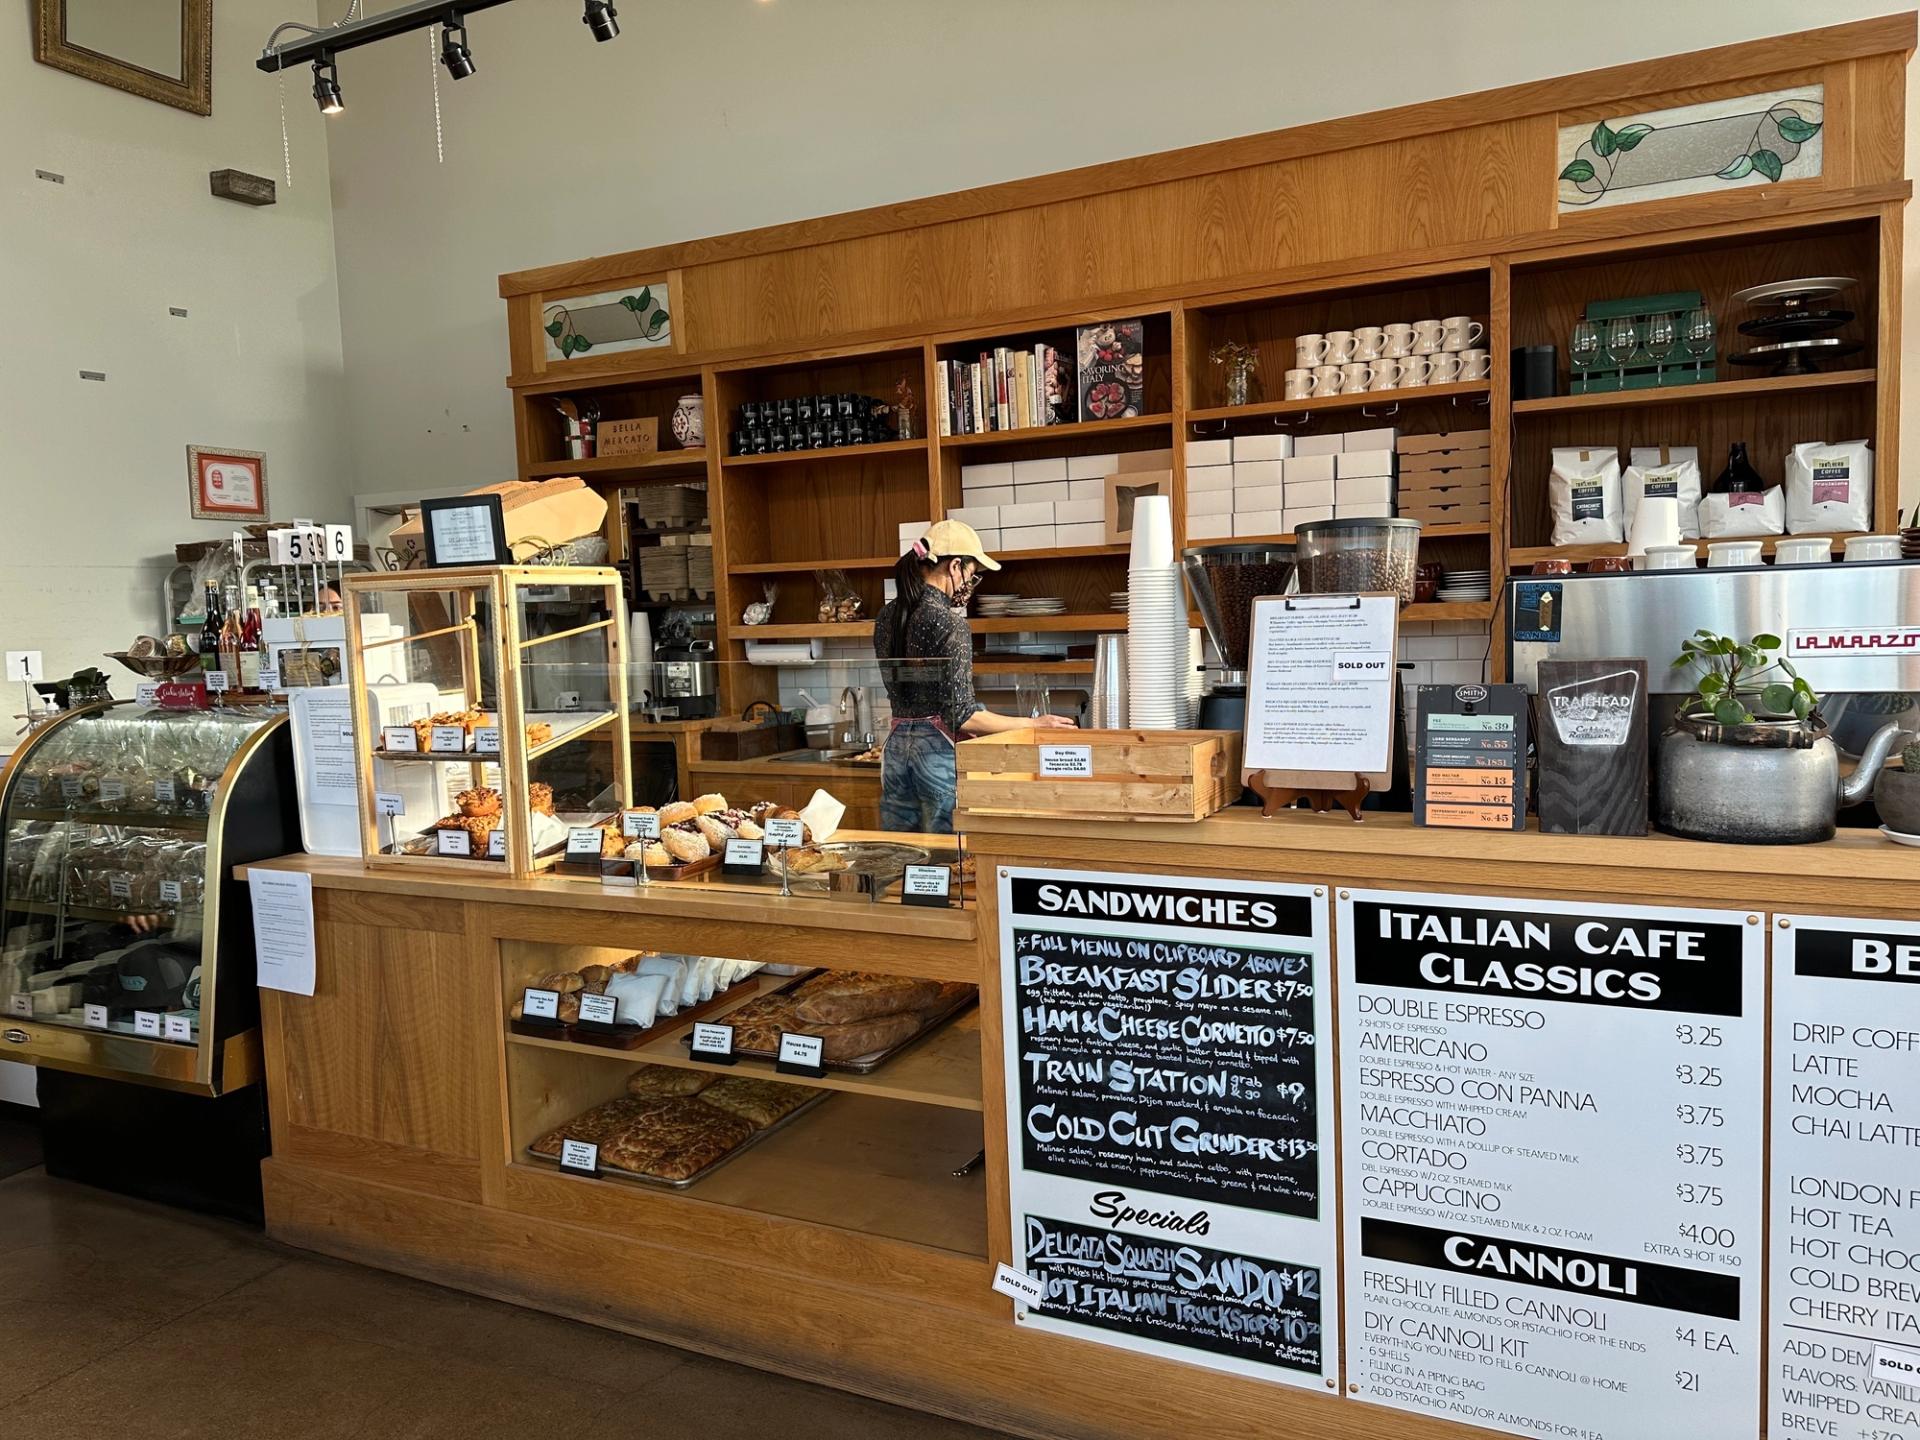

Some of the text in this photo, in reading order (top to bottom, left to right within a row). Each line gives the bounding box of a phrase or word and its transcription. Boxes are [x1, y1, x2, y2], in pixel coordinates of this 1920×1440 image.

[1082, 374, 1105, 384] ITALY
[613, 423, 641, 433] BELLA
[290, 535, 301, 558] 5
[335, 531, 344, 554] 6
[1828, 634, 1920, 648] MARZO
[1459, 689, 1483, 697] SMITH
[1553, 696, 1630, 707] TRAILHEAD
[1038, 885, 1277, 928] SANDWICHES
[1378, 908, 1706, 961] ITALIAN CAFE
[1071, 937, 1122, 958] MENU
[1126, 941, 1150, 960] ON
[1153, 943, 1241, 968] CLIPBOARD
[1241, 954, 1296, 975] ABOVE
[1019, 955, 1314, 1003] BREAKFAST SLIDER $7.50
[1418, 952, 1662, 1001] CLASSICS
[1181, 1015, 1276, 1047] CORNETTO
[1276, 1027, 1315, 1048] $7.50
[1358, 994, 1723, 1047] DOUBLE ESPRESSO $3.25
[1793, 1022, 1845, 1045] DRIP
[786, 1040, 801, 1048] House
[1359, 1031, 1723, 1087] AMERICANO $3.25
[1023, 1052, 1103, 1085] TRAIN
[1108, 1060, 1227, 1098] STATION
[1230, 1074, 1262, 1088] grab
[1792, 1053, 1858, 1078] LATTE
[1138, 1095, 1163, 1107] Dijon
[1245, 1090, 1260, 1100] go
[1360, 1067, 1724, 1127] ESPRESSO CON PANNA $3.75
[1792, 1084, 1893, 1112] MOCHA
[1027, 1102, 1105, 1142] COLD
[1108, 1110, 1169, 1149] CUT
[1169, 1116, 1284, 1162] GRINDER
[1360, 1103, 1724, 1167] MACCHIATO $3.75
[1792, 1115, 1850, 1139] CHAI
[1361, 1140, 1724, 1207] CORTADO $3.75
[1791, 1175, 1901, 1207] LONDON
[1090, 1191, 1210, 1236] Specials
[1362, 1176, 1736, 1248] CAPPUCCINO $4.00
[1790, 1206, 1893, 1237] HOT TEA
[1026, 1216, 1320, 1308] DELICATA SQUASH SANDO $12
[1643, 1242, 1680, 1257] EXTRA
[1683, 1248, 1715, 1263] SHOT
[1790, 1236, 1841, 1260] HOT
[1443, 1235, 1638, 1296] CANNOLI
[1789, 1266, 1860, 1293] COLD
[1000, 1274, 1039, 1297] SOLD OUT
[1364, 1270, 1739, 1355] FRESHLY FILLED CANNOLI $4 EA.
[1789, 1296, 1879, 1326] CHERRY
[1364, 1311, 1699, 1392] DIY CANNOLI KIT $21
[1369, 1346, 1410, 1363] 6 SHELLS
[1783, 1339, 1826, 1358] ADD
[1879, 1357, 1913, 1372] SOLD
[1782, 1364, 1920, 1403] FLAVORS: VANILL
[1782, 1388, 1920, 1427] WHIPPED CREA
[1782, 1412, 1838, 1437] BREVE
